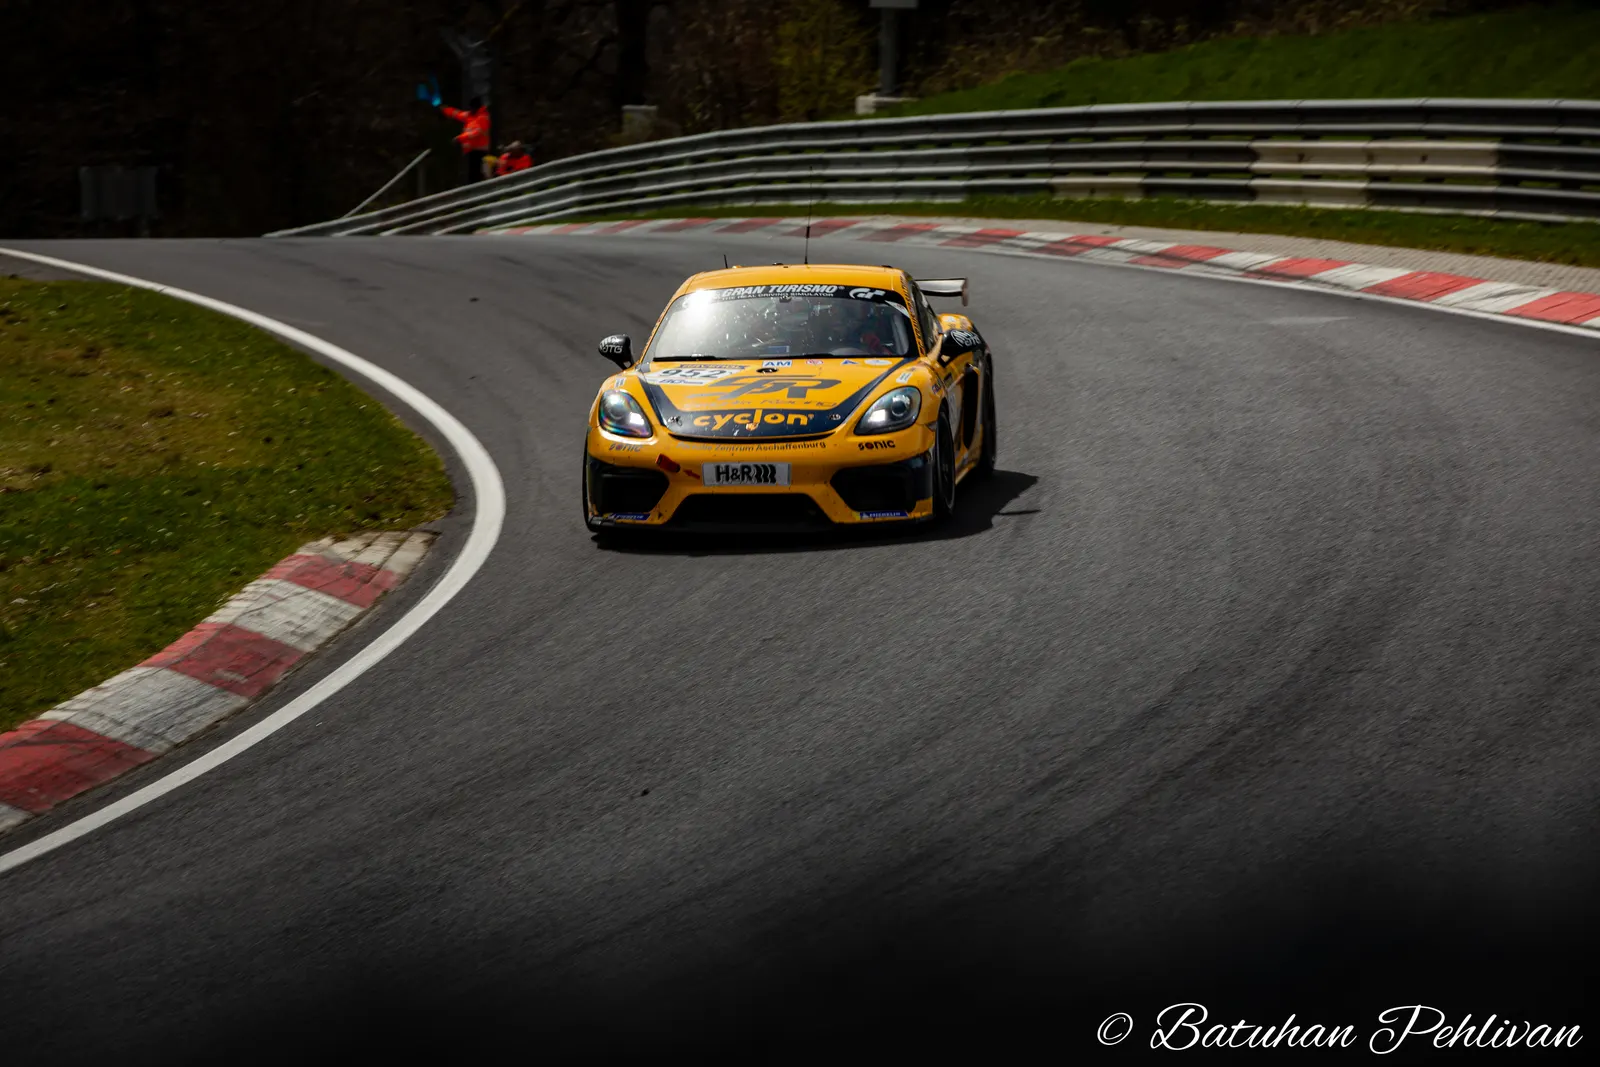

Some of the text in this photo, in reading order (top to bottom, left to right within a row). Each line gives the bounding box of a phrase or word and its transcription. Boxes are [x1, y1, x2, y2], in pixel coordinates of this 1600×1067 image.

[722, 284, 838, 297] GRAN TURISMO
[662, 369, 727, 379] 952
[693, 409, 808, 431] cyclon
[715, 443, 754, 452] Zentrum
[755, 441, 826, 452] Aschaffenburg
[858, 440, 895, 450] sonic
